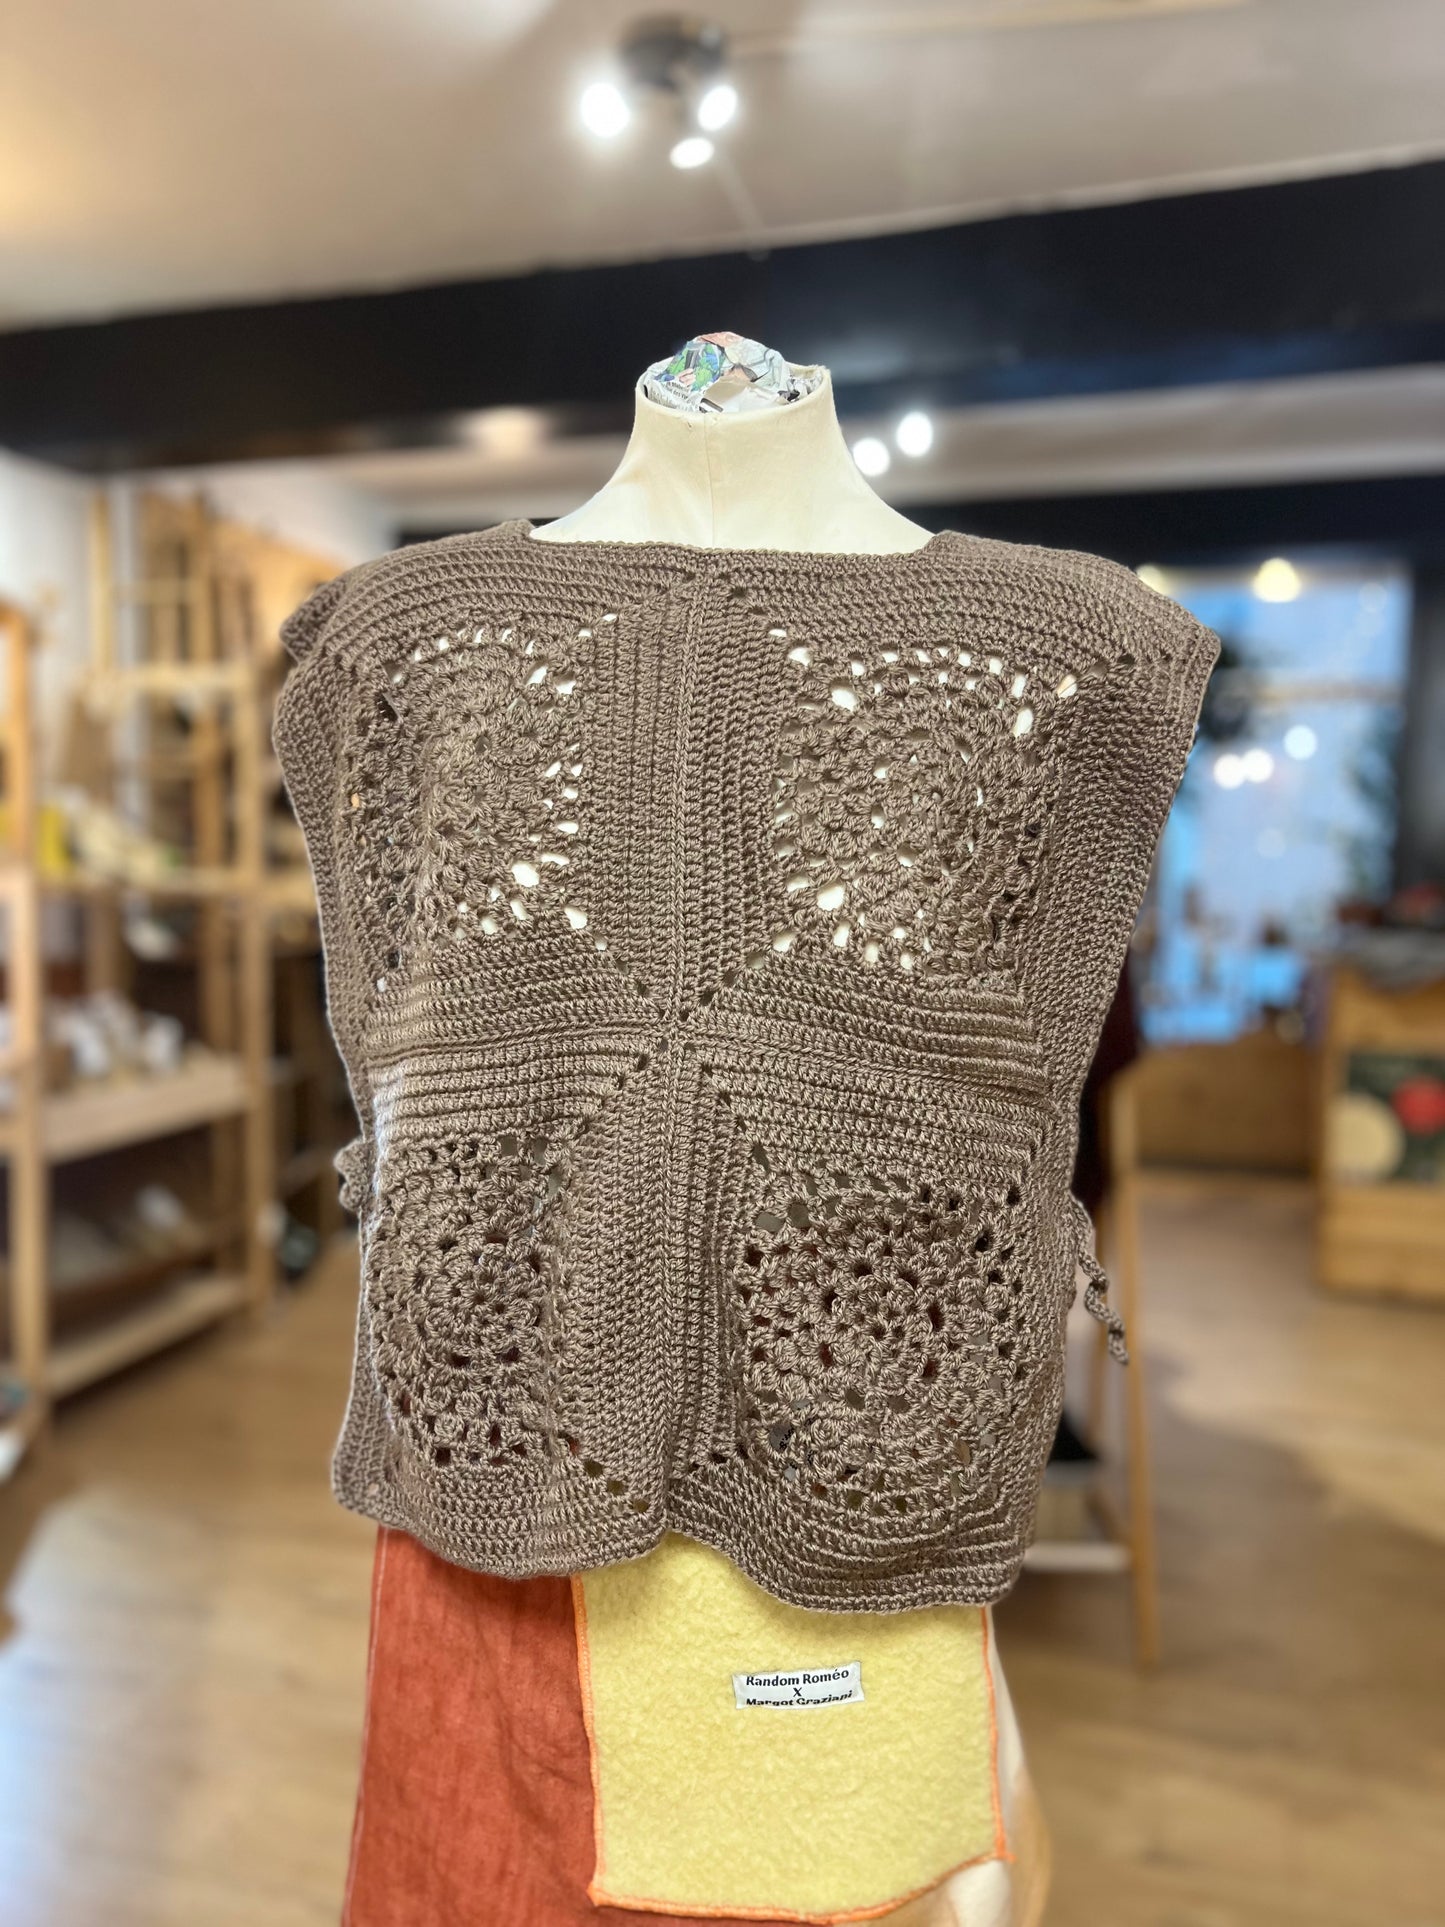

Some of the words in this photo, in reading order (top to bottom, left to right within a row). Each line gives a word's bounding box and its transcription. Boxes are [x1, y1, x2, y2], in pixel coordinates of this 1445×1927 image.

[746, 1675, 799, 1686] Random
[802, 1669, 849, 1684] Roméo
[746, 1698, 794, 1706] Margot
[796, 1690, 852, 1705] Graziani
[793, 1687, 802, 1697] X
